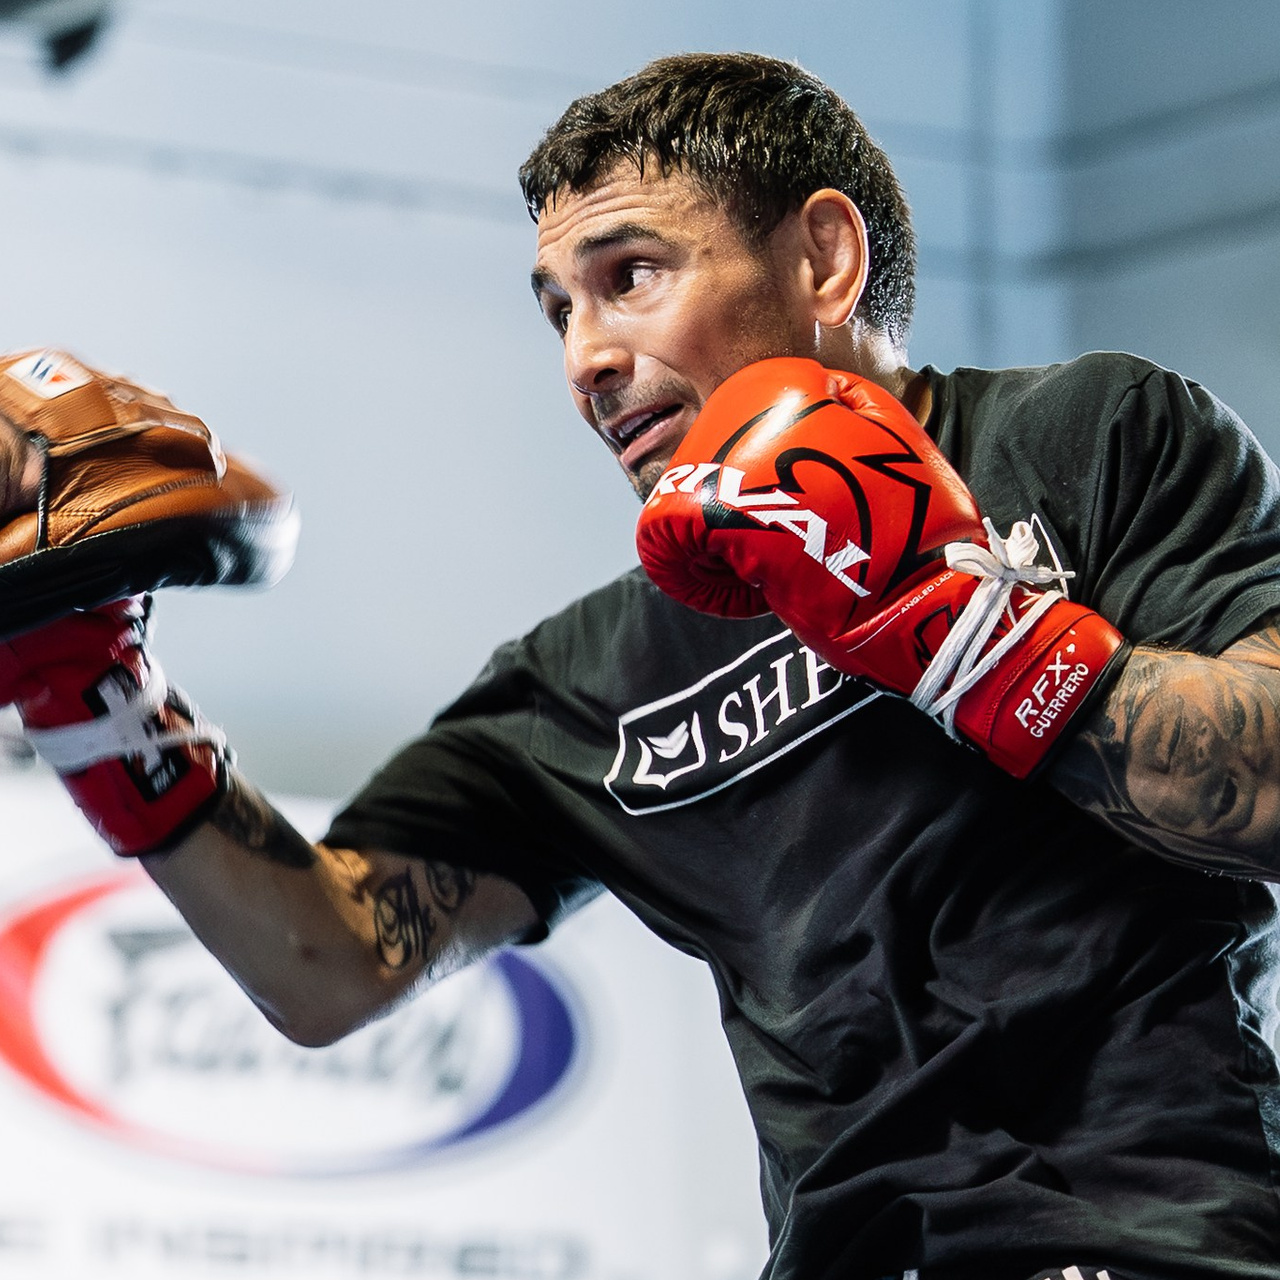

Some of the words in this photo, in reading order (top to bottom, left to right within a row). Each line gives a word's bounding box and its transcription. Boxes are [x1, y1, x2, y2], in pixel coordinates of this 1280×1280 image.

[645, 463, 872, 598] RIVAL
[901, 584, 935, 614] ANGLED
[718, 645, 846, 763] SHE
[1014, 650, 1071, 729] RFX
[1030, 663, 1089, 738] GUERRERO
